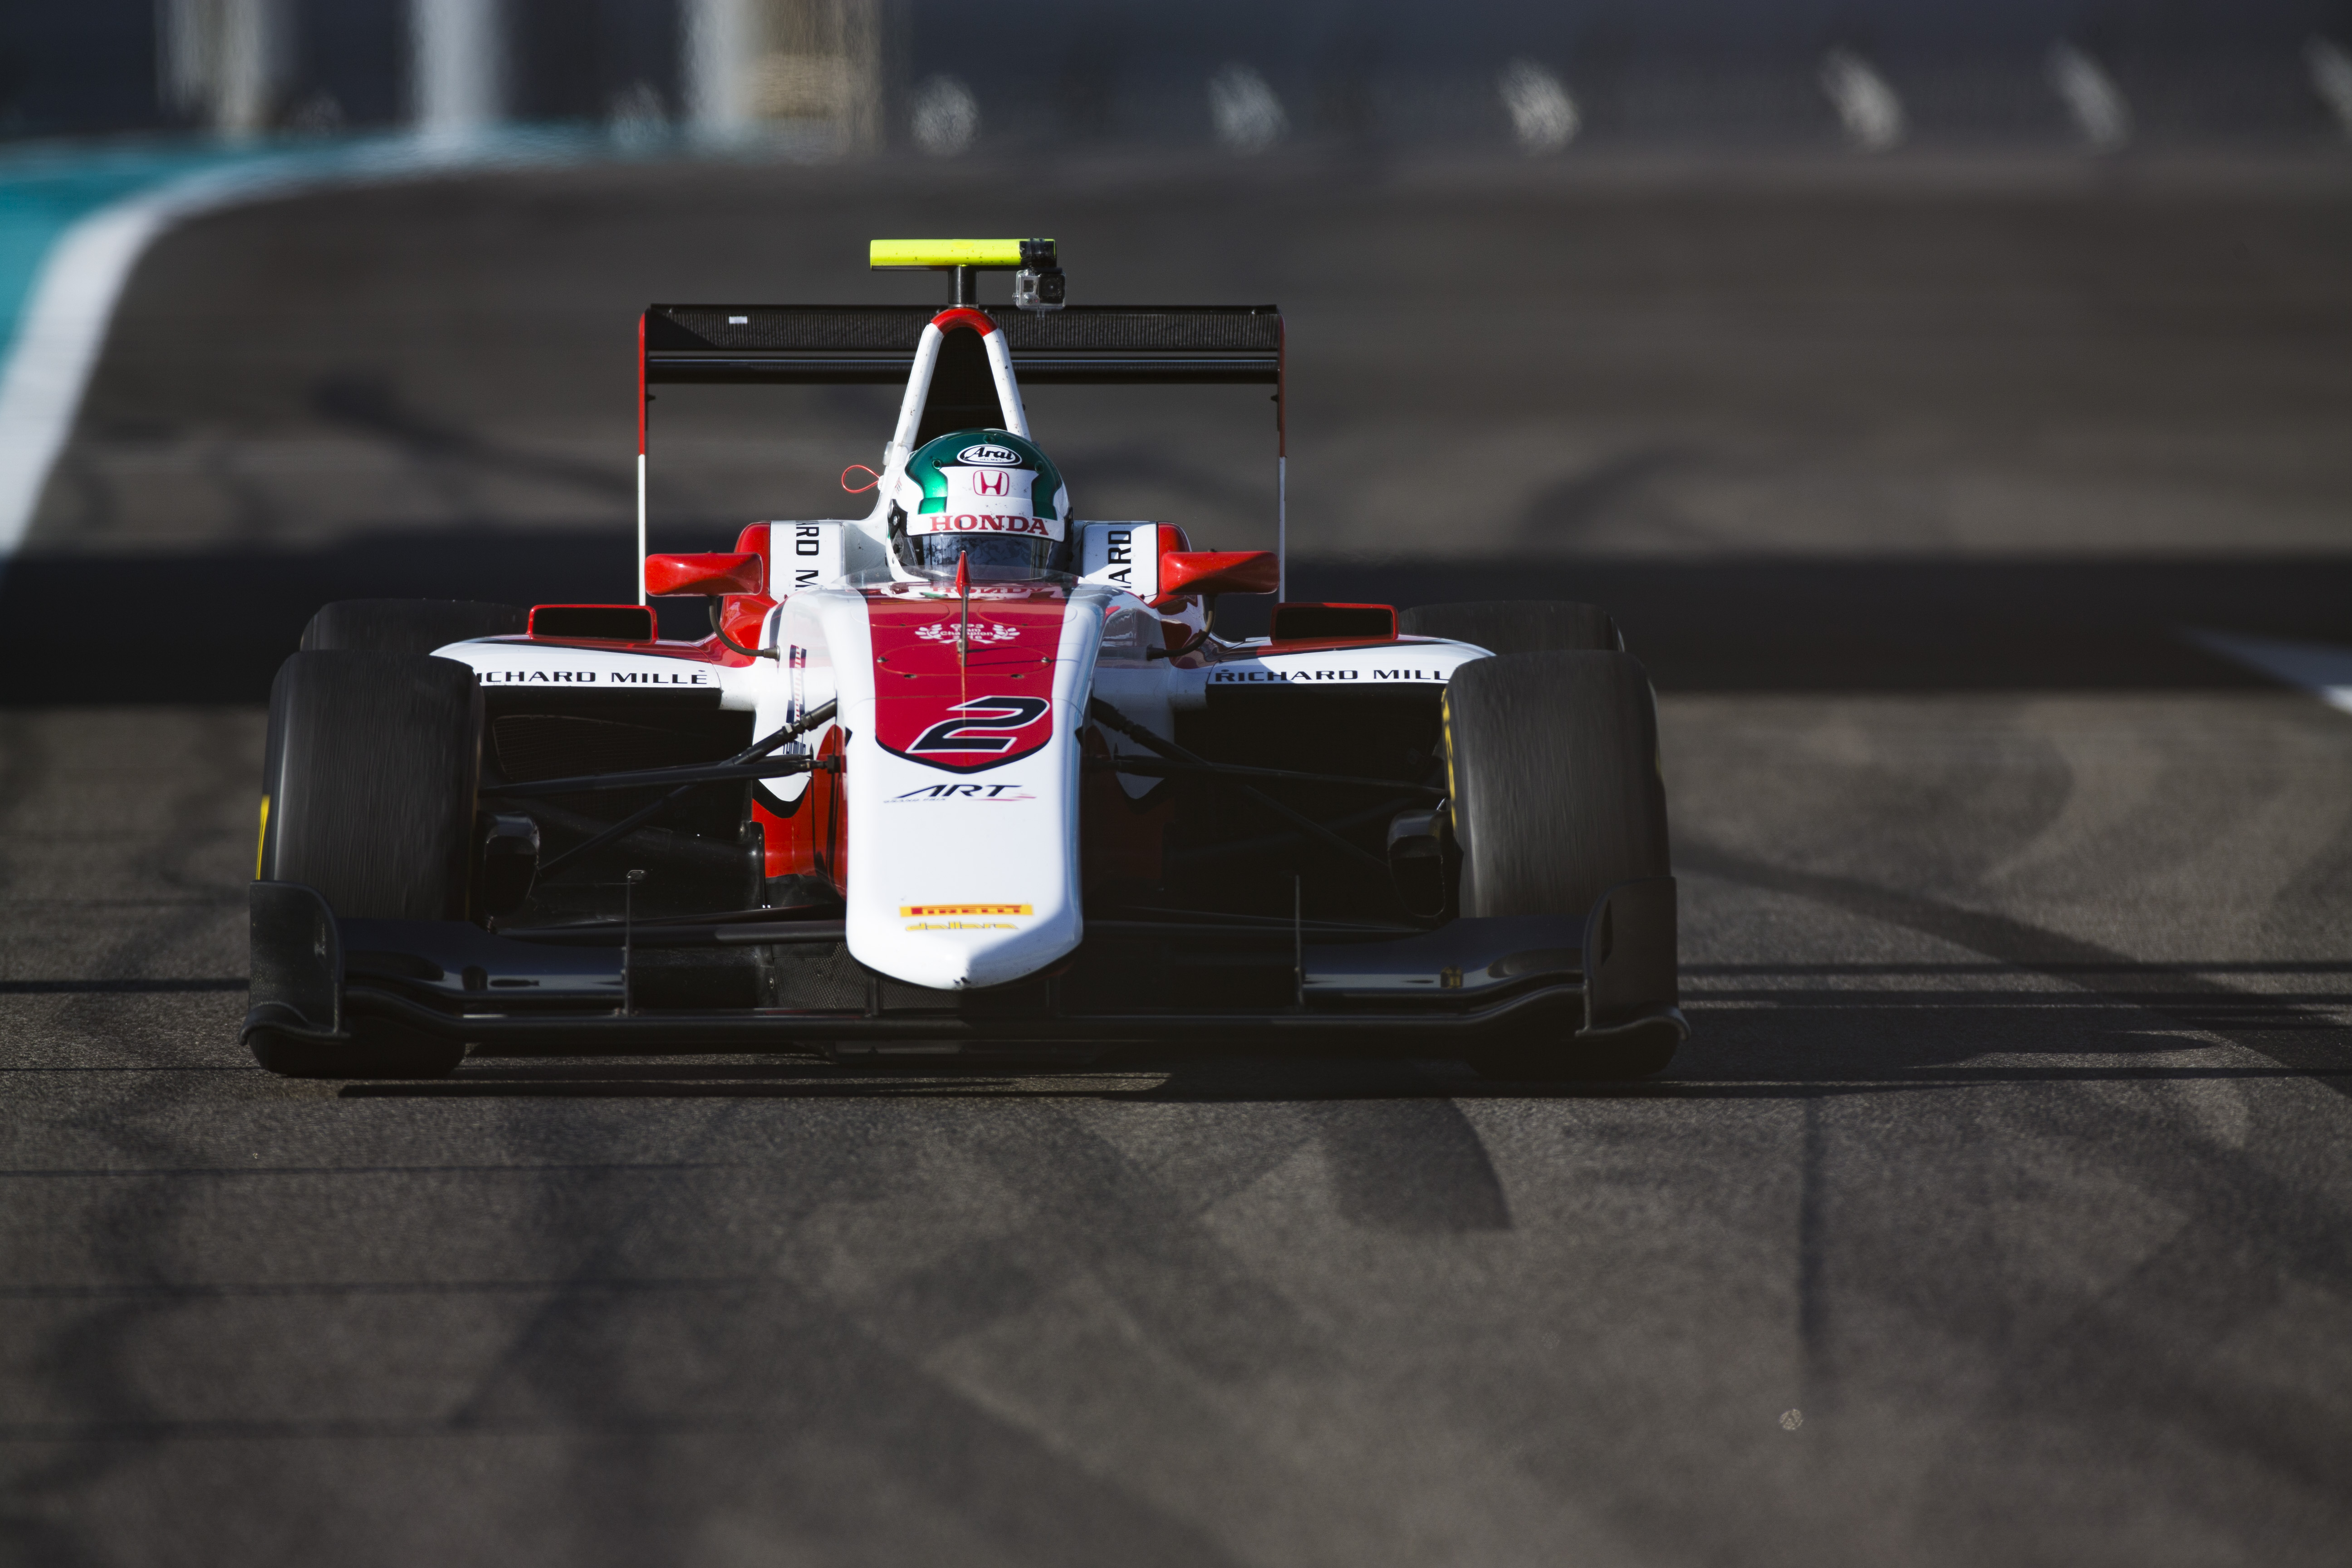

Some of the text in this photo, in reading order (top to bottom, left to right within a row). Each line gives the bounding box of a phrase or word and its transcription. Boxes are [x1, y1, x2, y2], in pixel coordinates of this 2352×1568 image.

[963, 447, 1014, 460] Arai
[930, 514, 1049, 536] HONDA
[796, 523, 819, 555] RD
[1108, 530, 1132, 588] ARD
[476, 671, 707, 684] ICHARD MILLE
[1215, 670, 1450, 682] RICHARD MILL
[906, 696, 1050, 753] 2
[893, 784, 1023, 799] ART
[911, 905, 1021, 915] PIRELLI
[906, 921, 1019, 931] dallara
